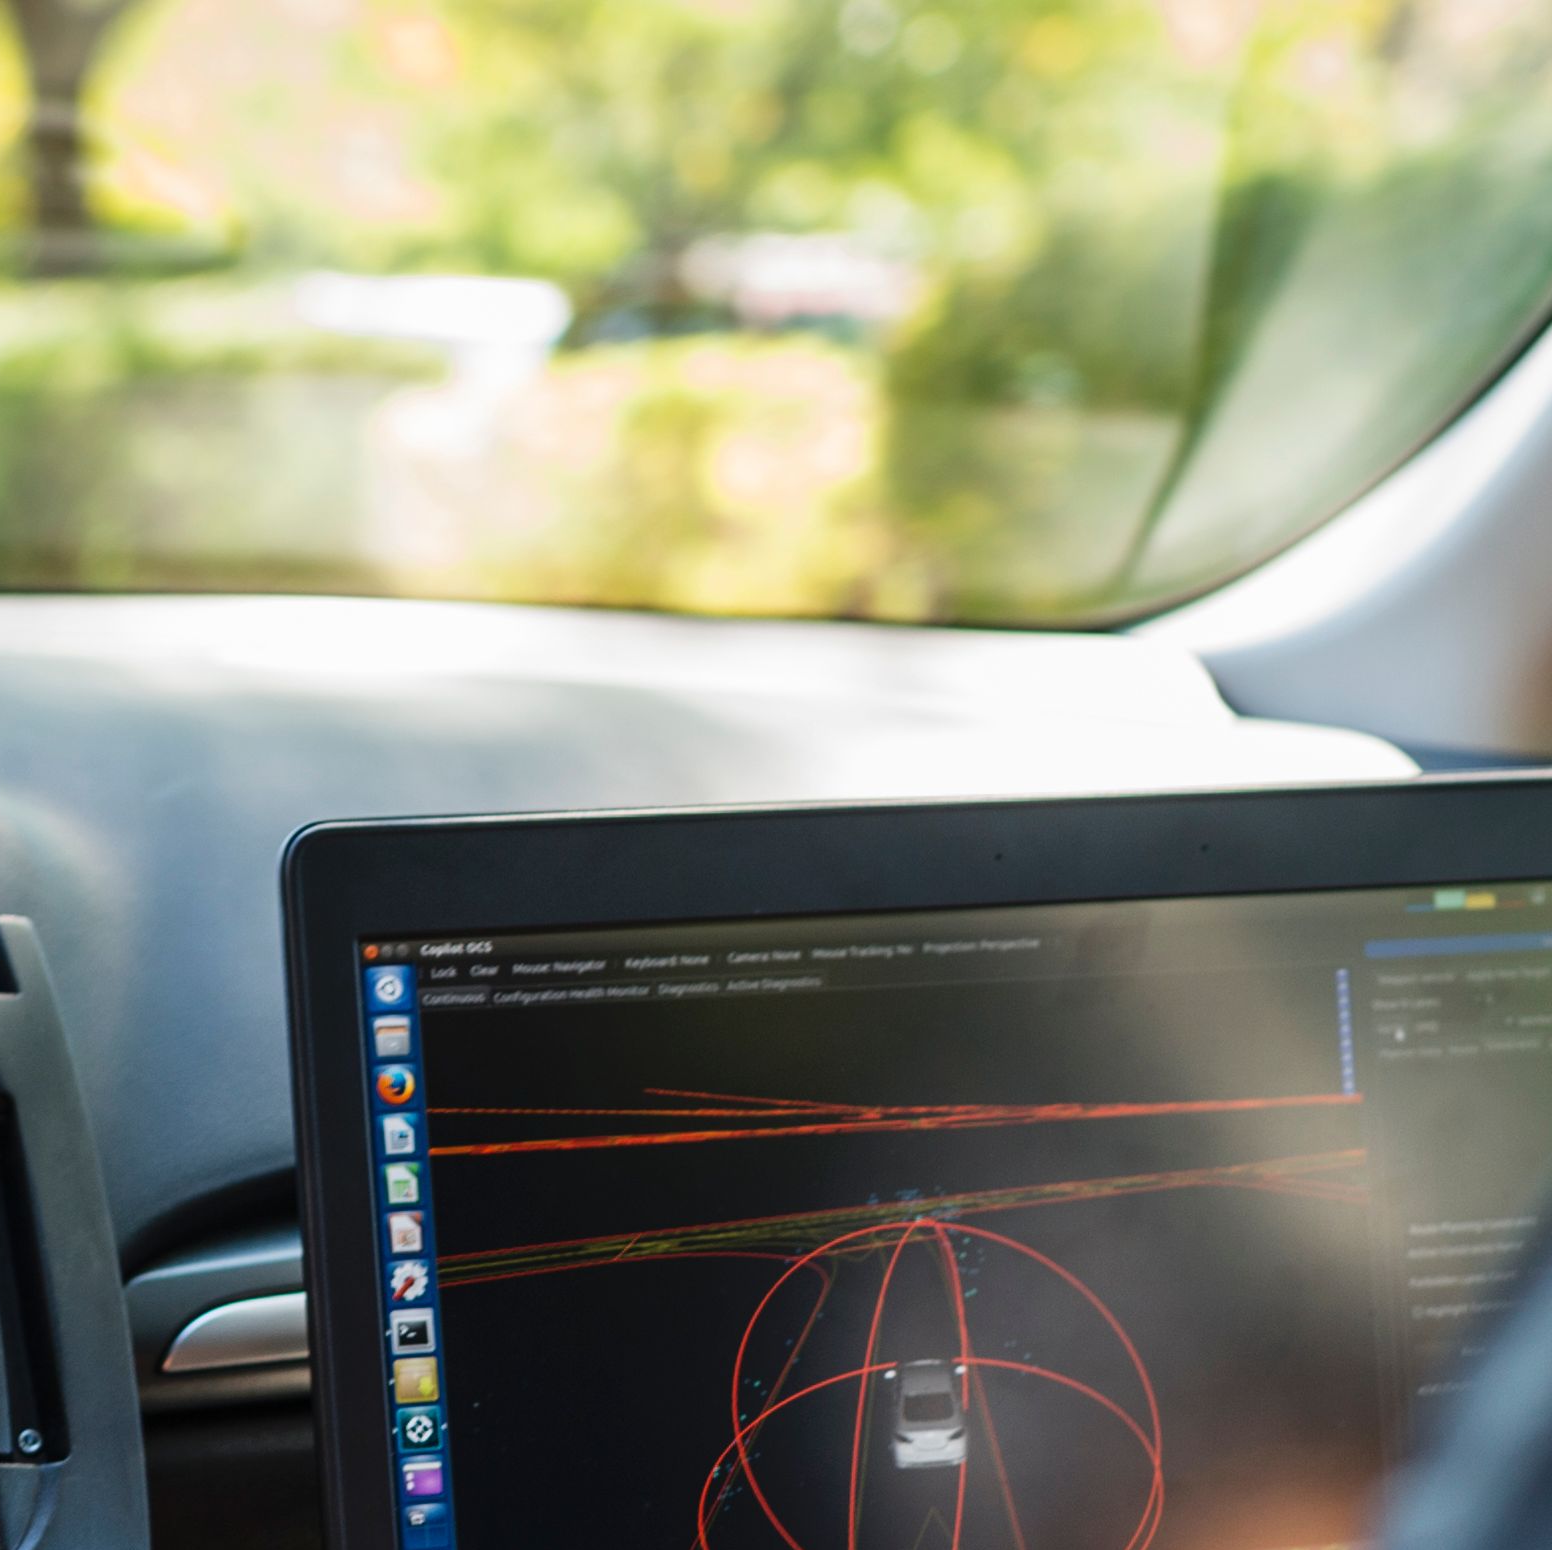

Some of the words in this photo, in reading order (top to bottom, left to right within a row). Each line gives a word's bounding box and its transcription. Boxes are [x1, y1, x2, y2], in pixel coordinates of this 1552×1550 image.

[420, 943, 464, 957] Copilot
[431, 966, 457, 979] Lock
[470, 964, 498, 977] Clear
[553, 960, 606, 974] Navigator
[658, 981, 720, 997] Diagnostics
[727, 980, 760, 991] Active
[761, 977, 823, 992] Diagnostics
[493, 991, 567, 1005] Configuration
[570, 988, 605, 999] Health
[607, 985, 649, 997] Monitor
